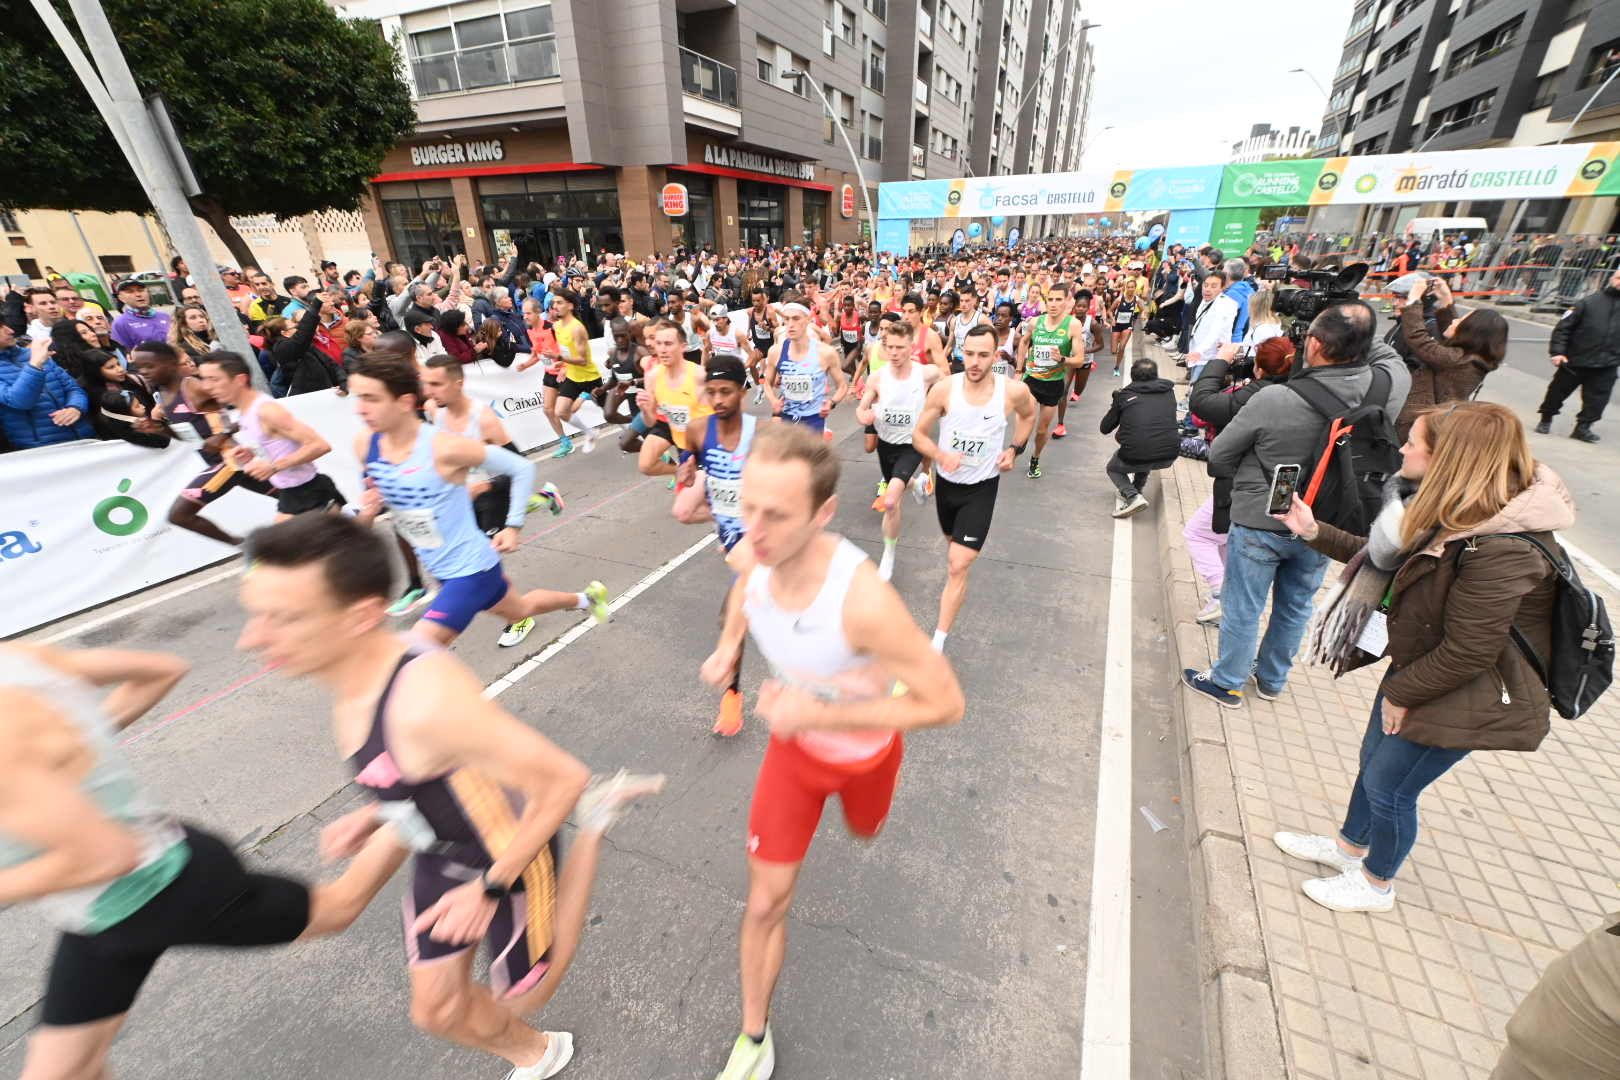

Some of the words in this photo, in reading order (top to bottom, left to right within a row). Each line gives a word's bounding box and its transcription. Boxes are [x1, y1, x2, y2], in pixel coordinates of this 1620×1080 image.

[410, 143, 465, 166] BURGER
[465, 140, 503, 162] KING
[704, 144, 713, 163] A
[714, 145, 729, 166] LA
[729, 149, 774, 175] PARRILLA
[1396, 168, 1468, 191] marató
[1470, 164, 1558, 189] CASTELLÓ
[1047, 189, 1095, 205] CASTELLÓ
[785, 381, 809, 391] 2010
[885, 413, 911, 425] 2128
[952, 438, 984, 454] 2127
